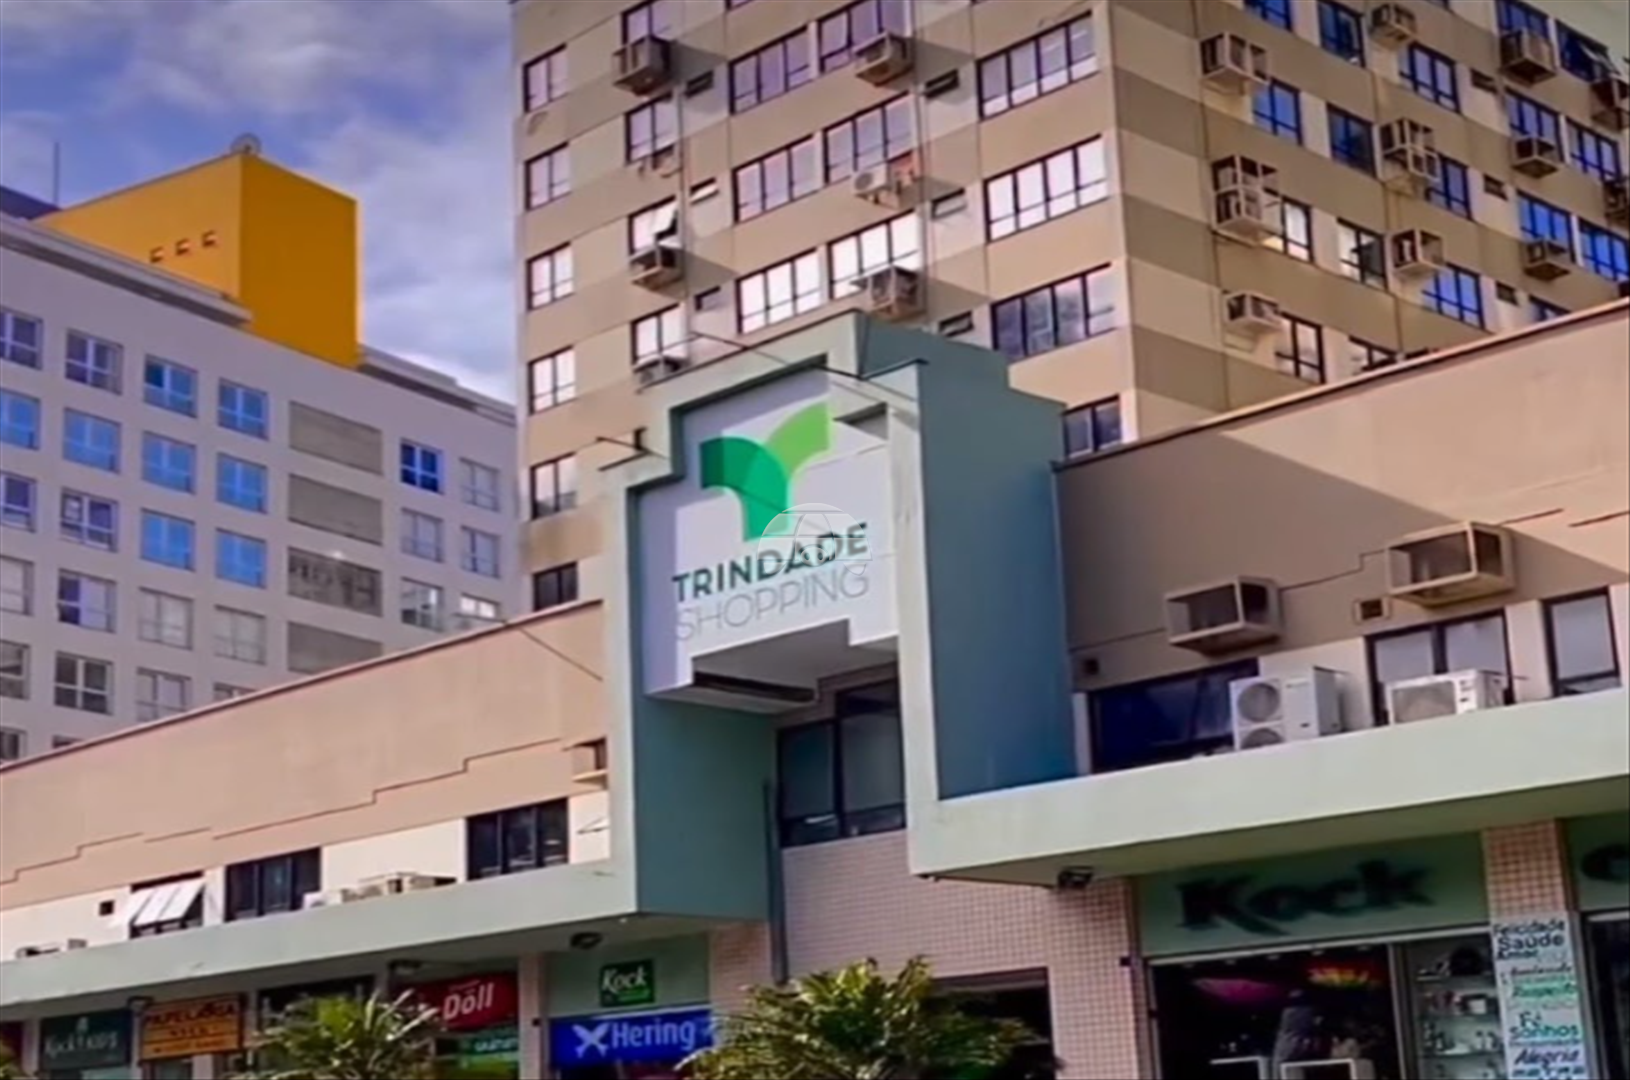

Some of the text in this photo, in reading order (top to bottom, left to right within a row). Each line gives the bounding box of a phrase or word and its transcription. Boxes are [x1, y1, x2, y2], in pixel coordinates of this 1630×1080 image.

[671, 521, 869, 603] TRINDADE
[674, 566, 870, 642] SHOPPING
[1175, 858, 1436, 936] Kock
[611, 1018, 696, 1052] Hering
